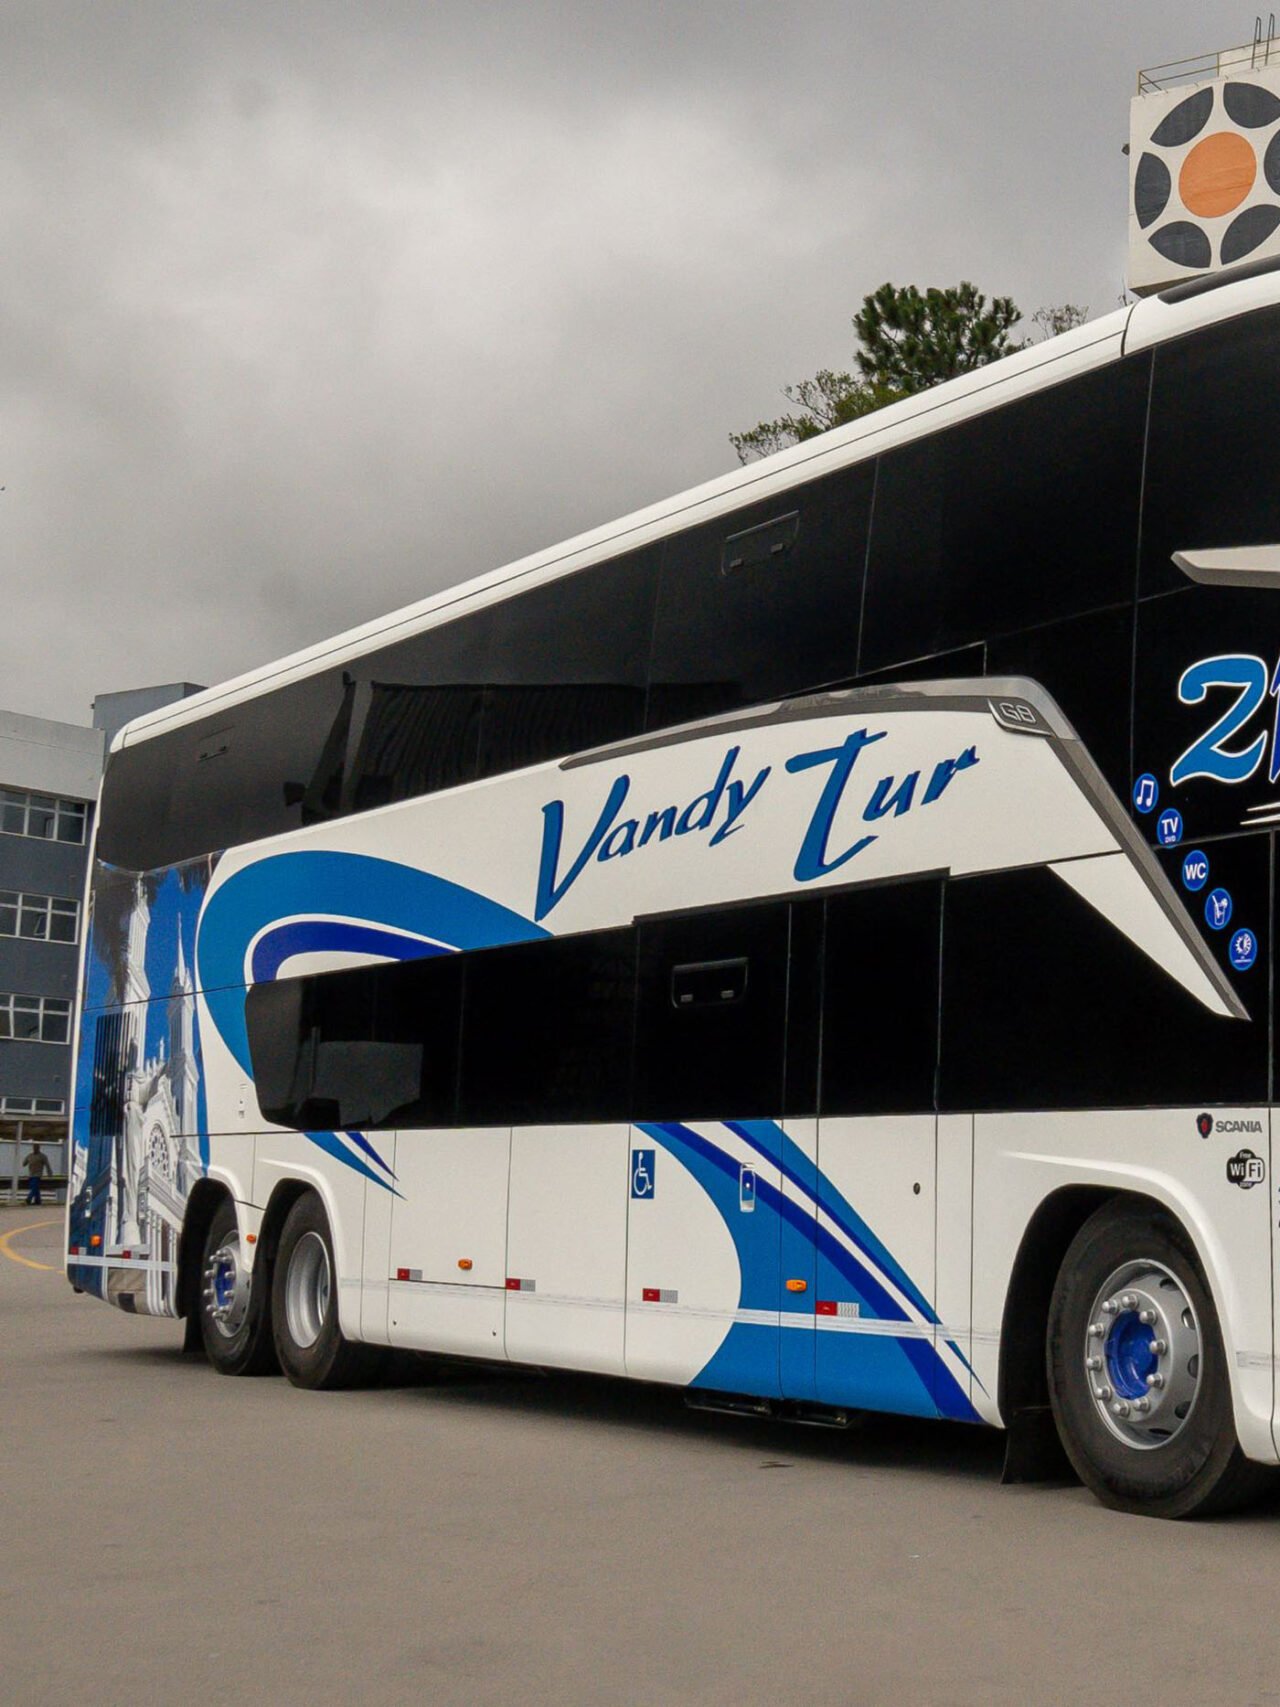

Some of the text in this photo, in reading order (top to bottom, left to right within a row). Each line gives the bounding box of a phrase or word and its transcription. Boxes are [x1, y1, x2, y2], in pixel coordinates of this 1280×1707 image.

[534, 728, 981, 922] Vandy Tur
[1162, 817, 1179, 835] TV
[1185, 862, 1207, 880] WC
[1215, 1120, 1263, 1134] SCANIA
